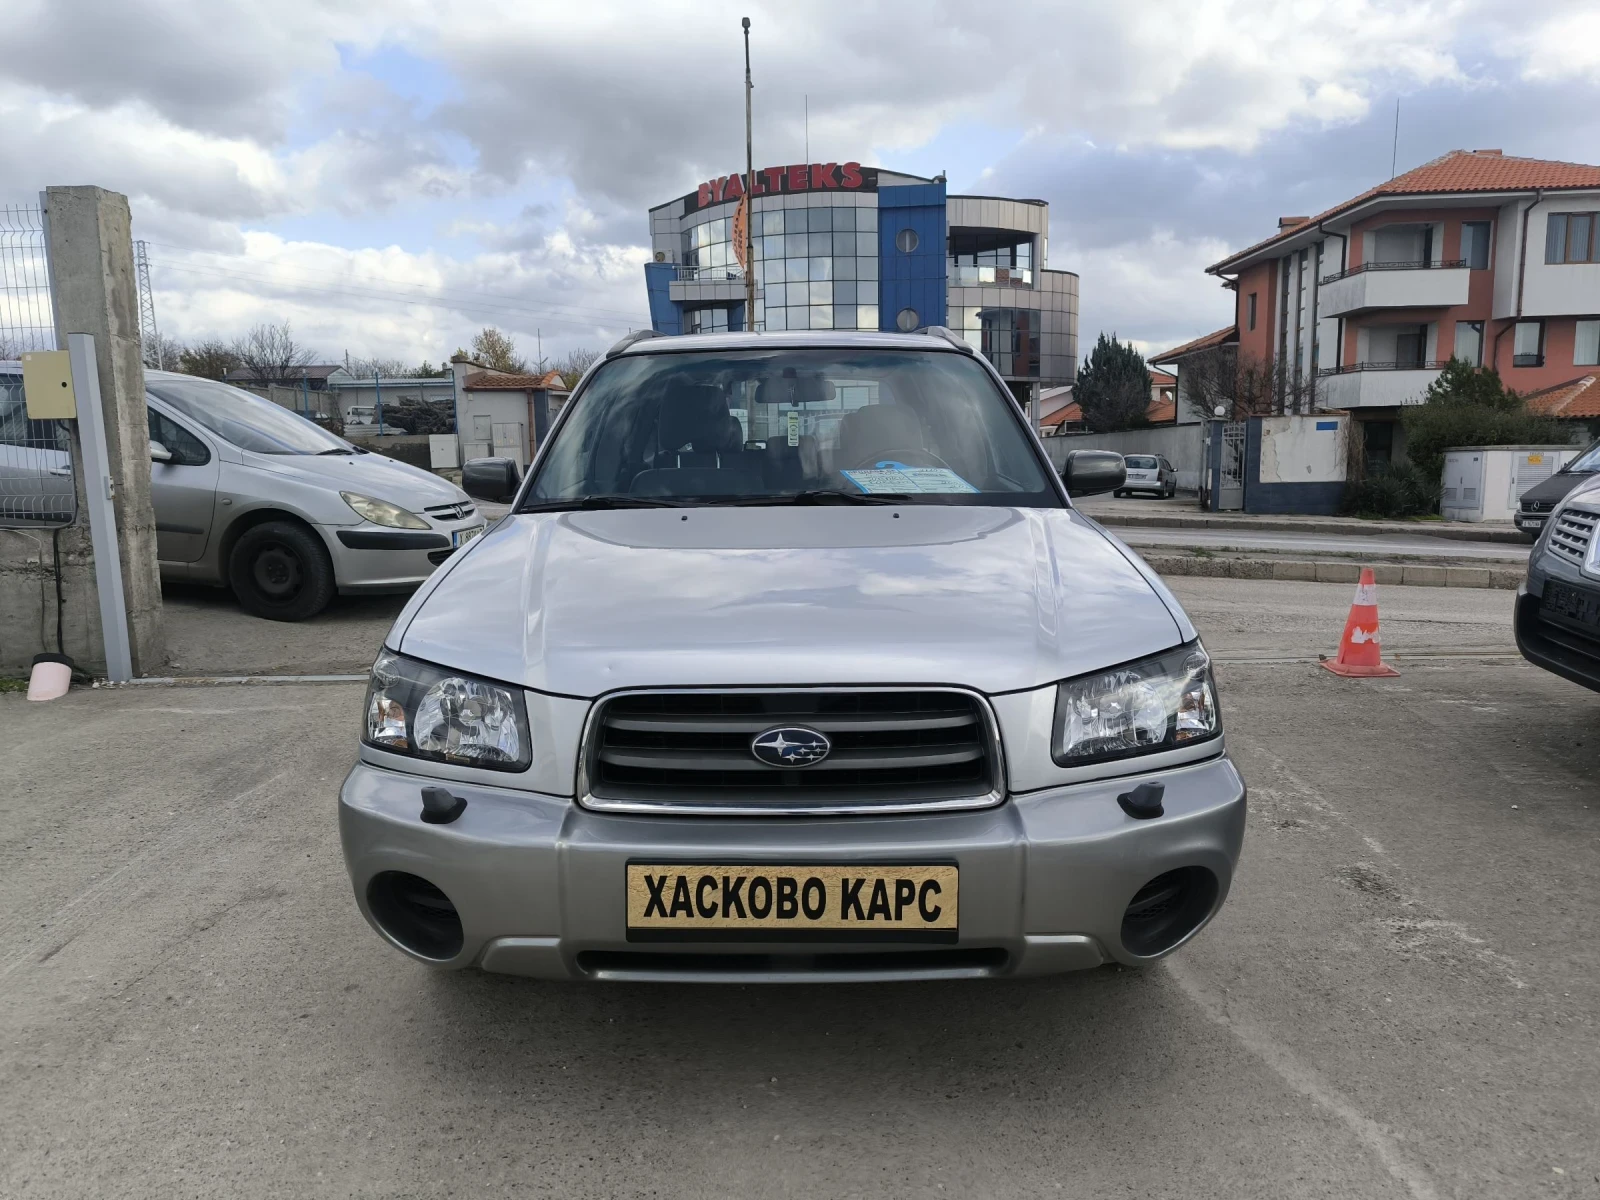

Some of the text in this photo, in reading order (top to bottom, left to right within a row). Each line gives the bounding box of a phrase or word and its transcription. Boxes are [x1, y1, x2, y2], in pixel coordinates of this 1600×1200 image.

[698, 161, 863, 208] BYALTEKS
[643, 874, 942, 922] ХАСКОВО КАРС
